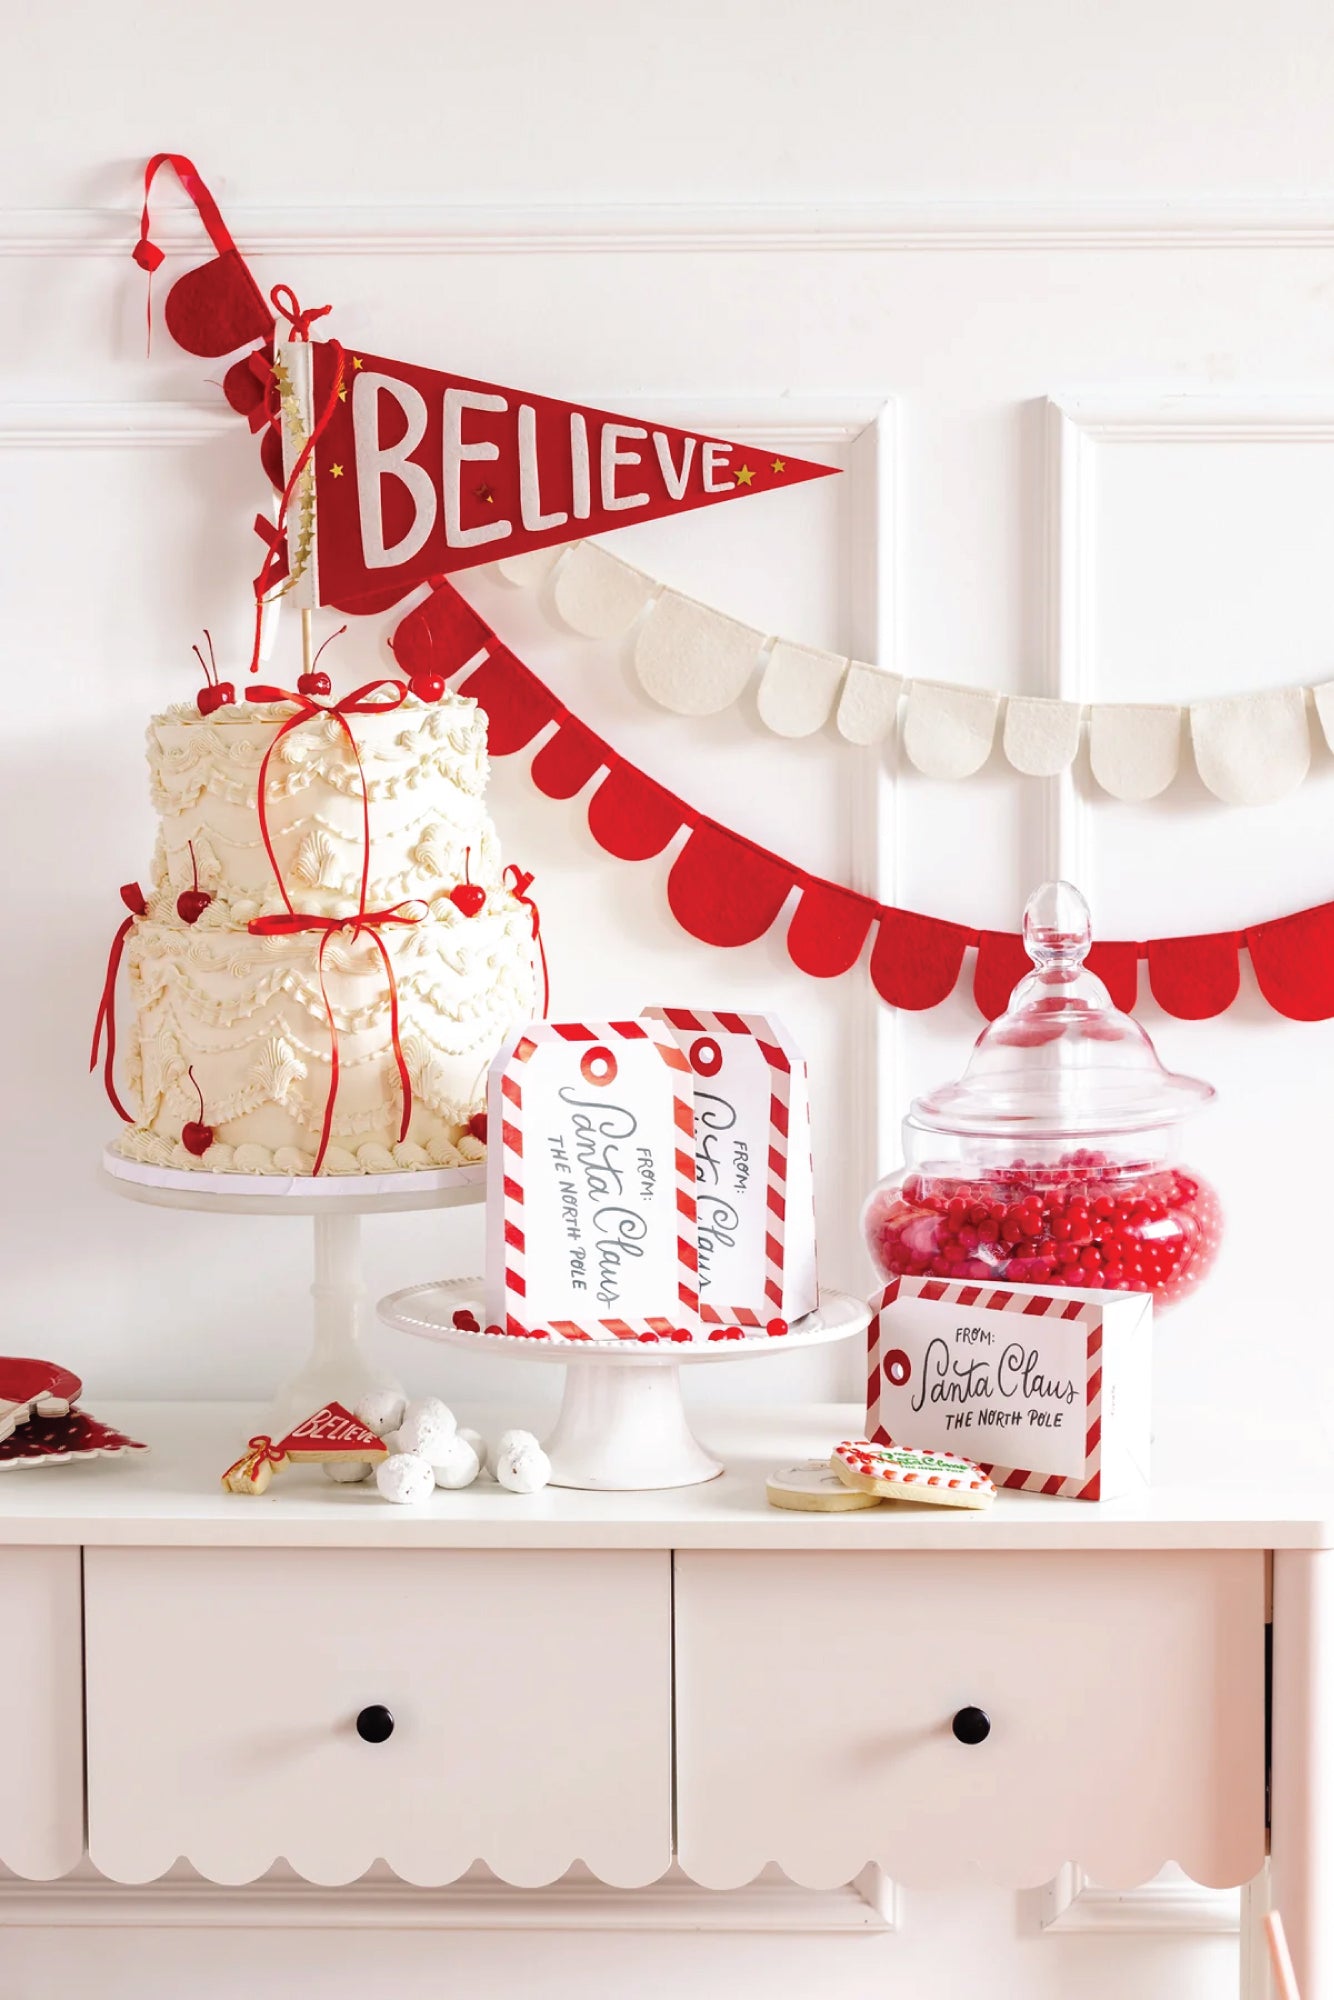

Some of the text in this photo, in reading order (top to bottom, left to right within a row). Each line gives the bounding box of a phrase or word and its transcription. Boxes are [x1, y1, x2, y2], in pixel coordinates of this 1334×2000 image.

[352, 371, 737, 569] BELIEVE
[635, 1147, 656, 1201] FROM:
[733, 1141, 750, 1194] FROM:
[547, 1135, 588, 1291] THE NORTH POLE
[558, 1086, 648, 1310] Santa Claus
[955, 1327, 996, 1346] FROM:
[911, 1338, 995, 1412] Santa
[997, 1342, 1080, 1405] Claus
[292, 1409, 378, 1444] BELIEVE
[945, 1408, 1064, 1431] THE NORTH POLE
